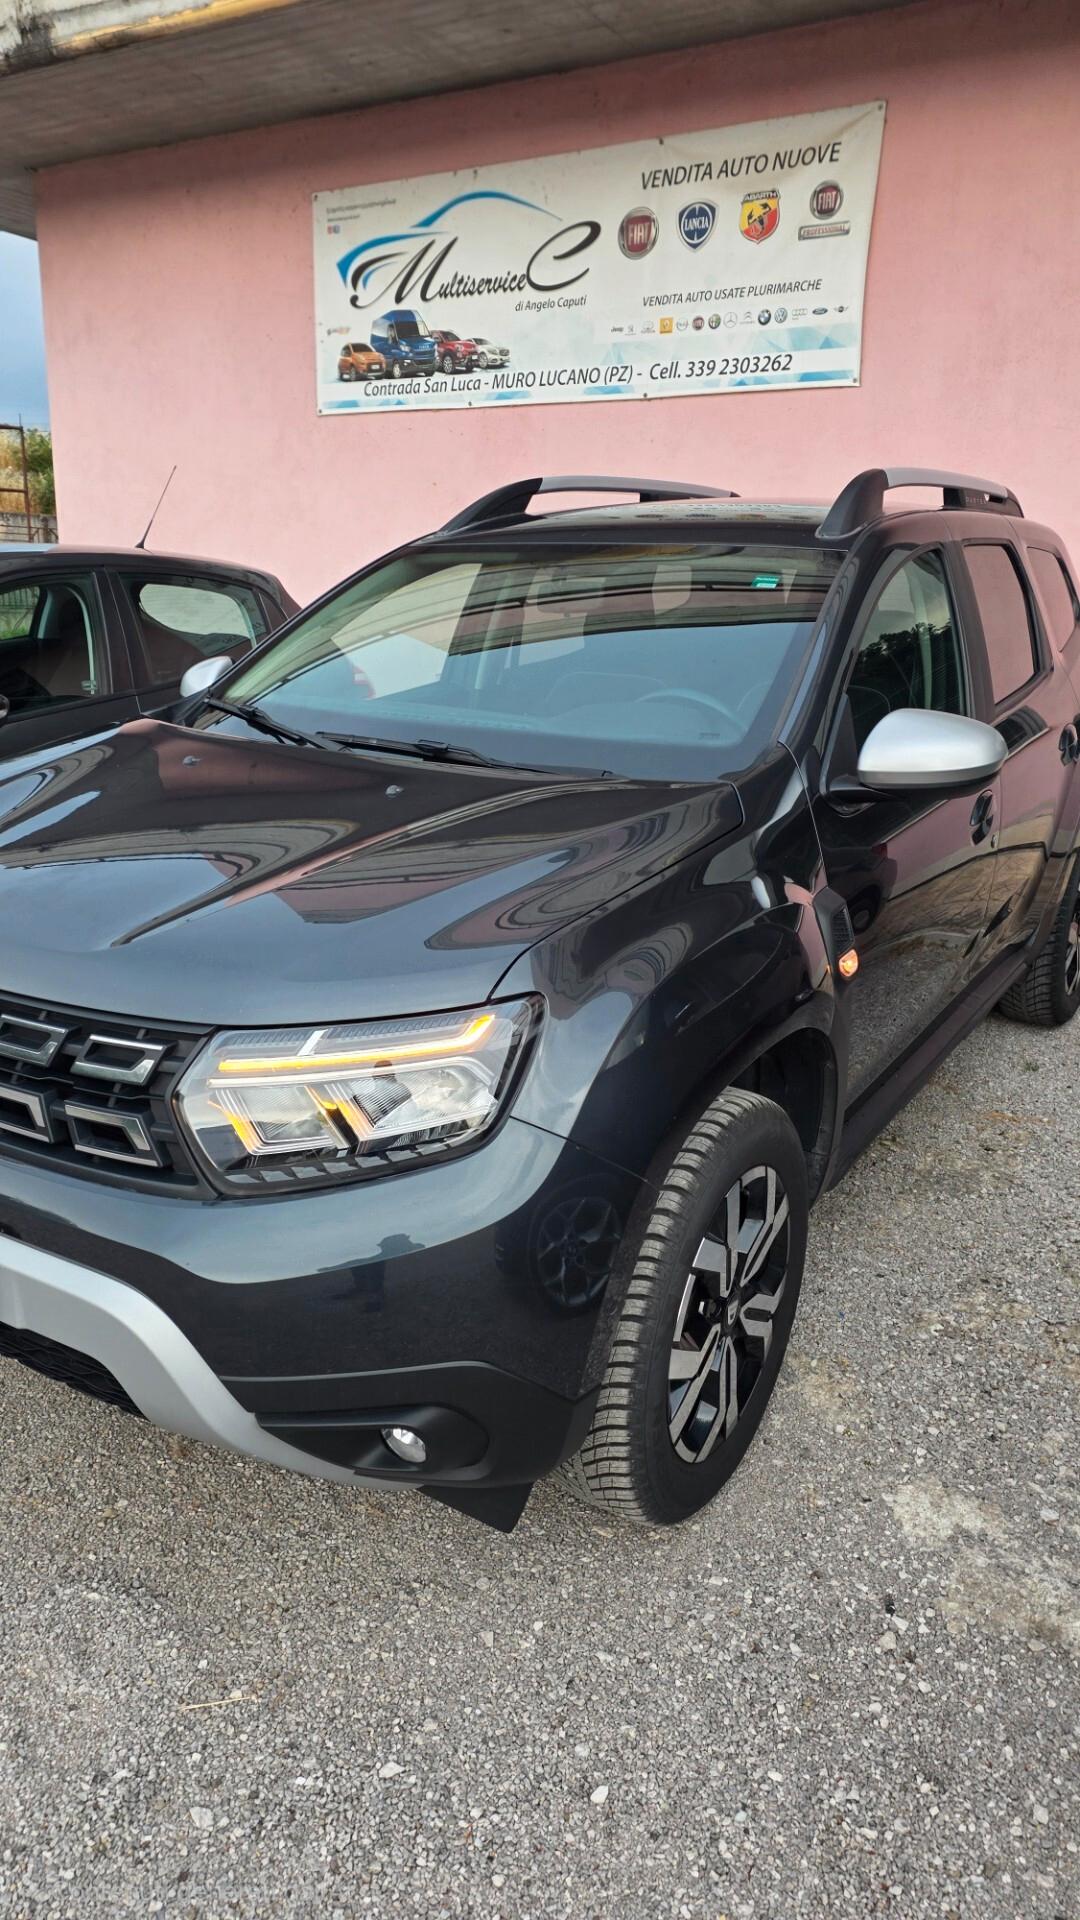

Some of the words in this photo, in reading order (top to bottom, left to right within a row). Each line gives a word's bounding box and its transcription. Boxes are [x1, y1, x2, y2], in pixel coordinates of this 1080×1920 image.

[641, 162, 713, 190] VENDITA
[717, 153, 769, 180] AUTO
[772, 142, 842, 172] NUOVE
[744, 190, 778, 201] ABARTH
[817, 190, 838, 209] FIAT
[629, 223, 650, 246] FIAT
[684, 216, 711, 232] LANCIA
[350, 236, 527, 309] Multiservice
[515, 302, 524, 312] di
[525, 297, 556, 313] Angelo
[557, 295, 587, 311] Caputi
[642, 294, 684, 307] VENDITA
[684, 290, 713, 304] AUTO
[714, 286, 746, 301] USATE
[747, 278, 823, 298] PLURIMARCHE
[364, 378, 421, 397] Contrada
[424, 378, 448, 394] San
[451, 375, 481, 392] Luca
[491, 371, 536, 390] MURO
[539, 367, 601, 387] LUCANO
[603, 364, 633, 386] (PZ)
[649, 360, 682, 381] Cell.
[685, 358, 716, 379] 339
[718, 353, 793, 376] 2303262
